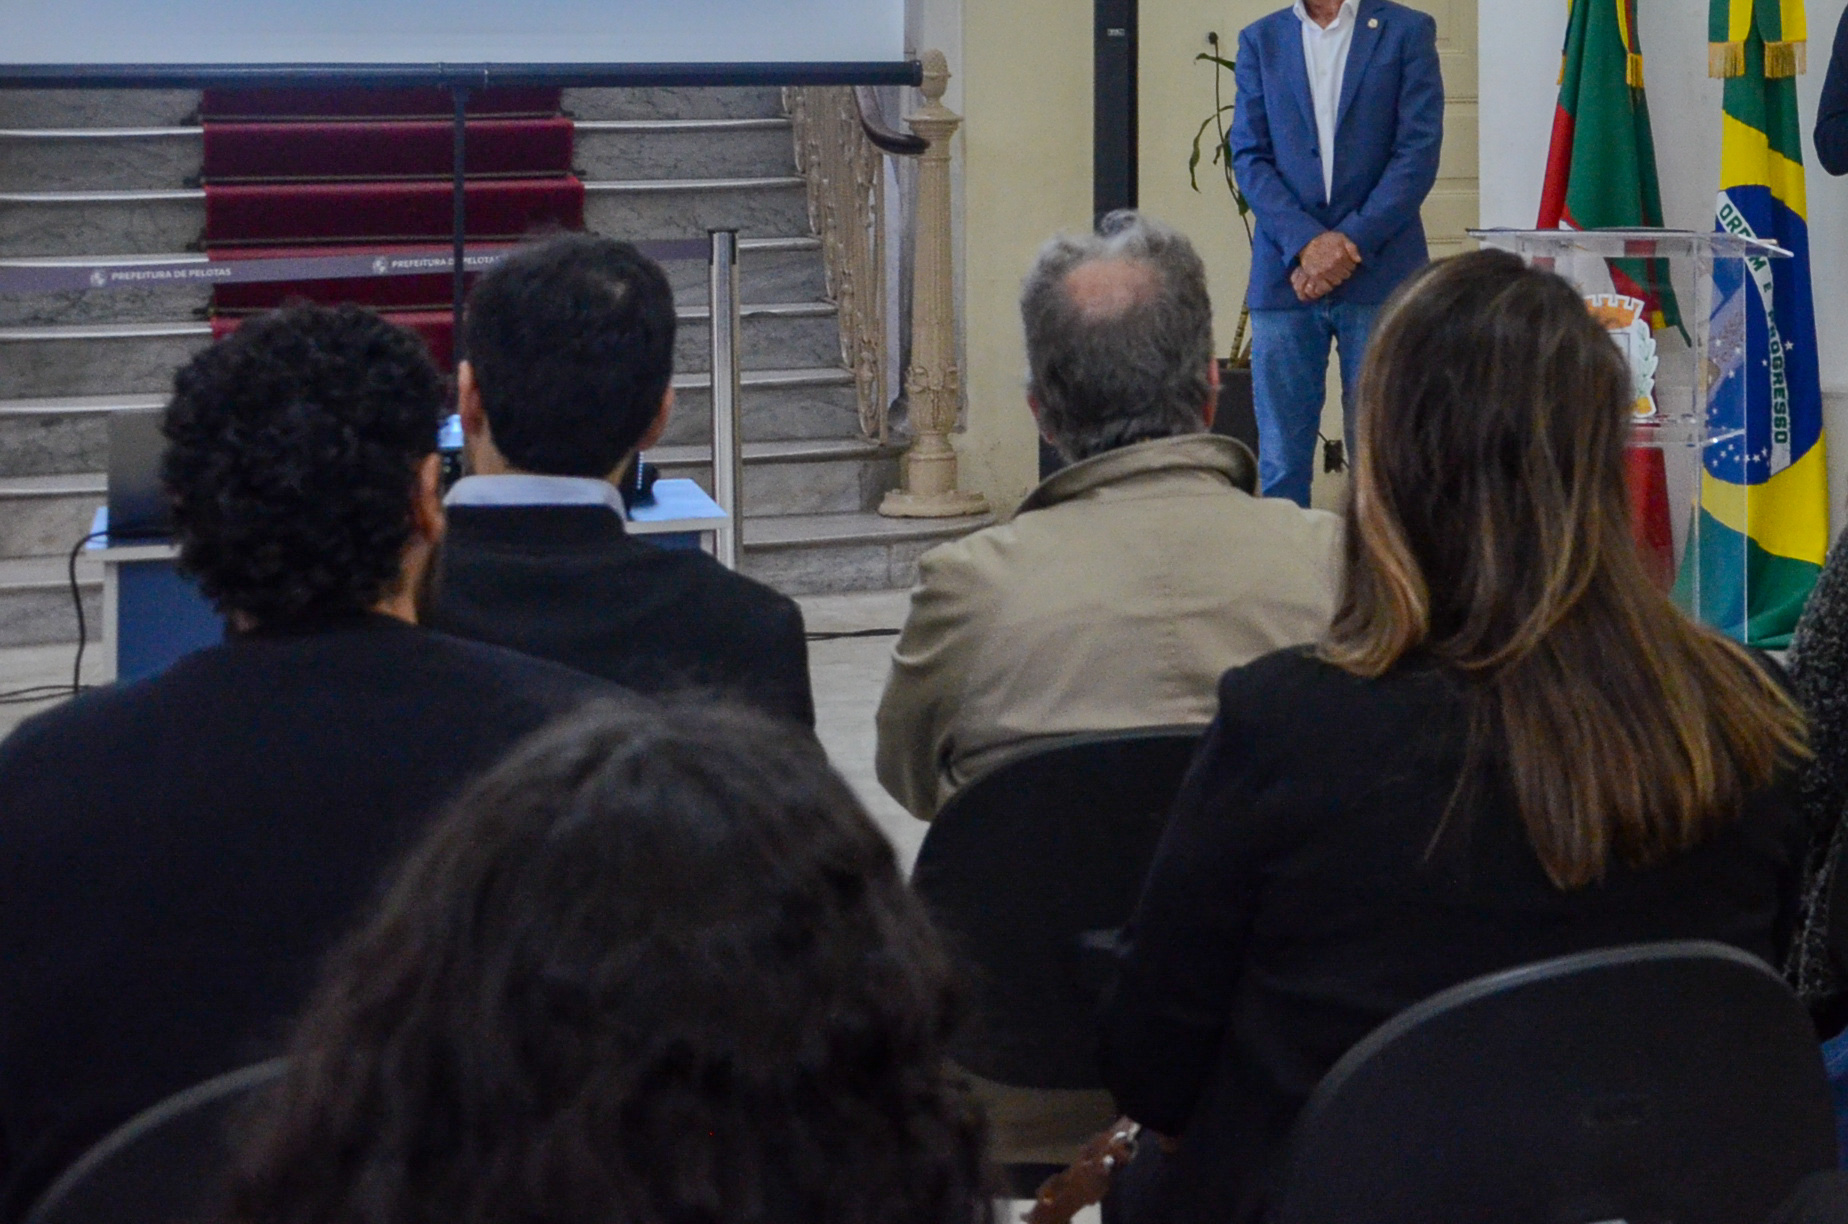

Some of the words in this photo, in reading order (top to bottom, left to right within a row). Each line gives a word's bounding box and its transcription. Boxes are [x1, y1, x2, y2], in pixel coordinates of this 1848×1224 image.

[1719, 203, 1767, 272] ORDM
[392, 257, 446, 268] PREFEITURA
[463, 255, 500, 265] PELOTA
[111, 270, 172, 281] PREFEITURA
[174, 270, 187, 278] DE
[189, 267, 232, 277] PELOTAS
